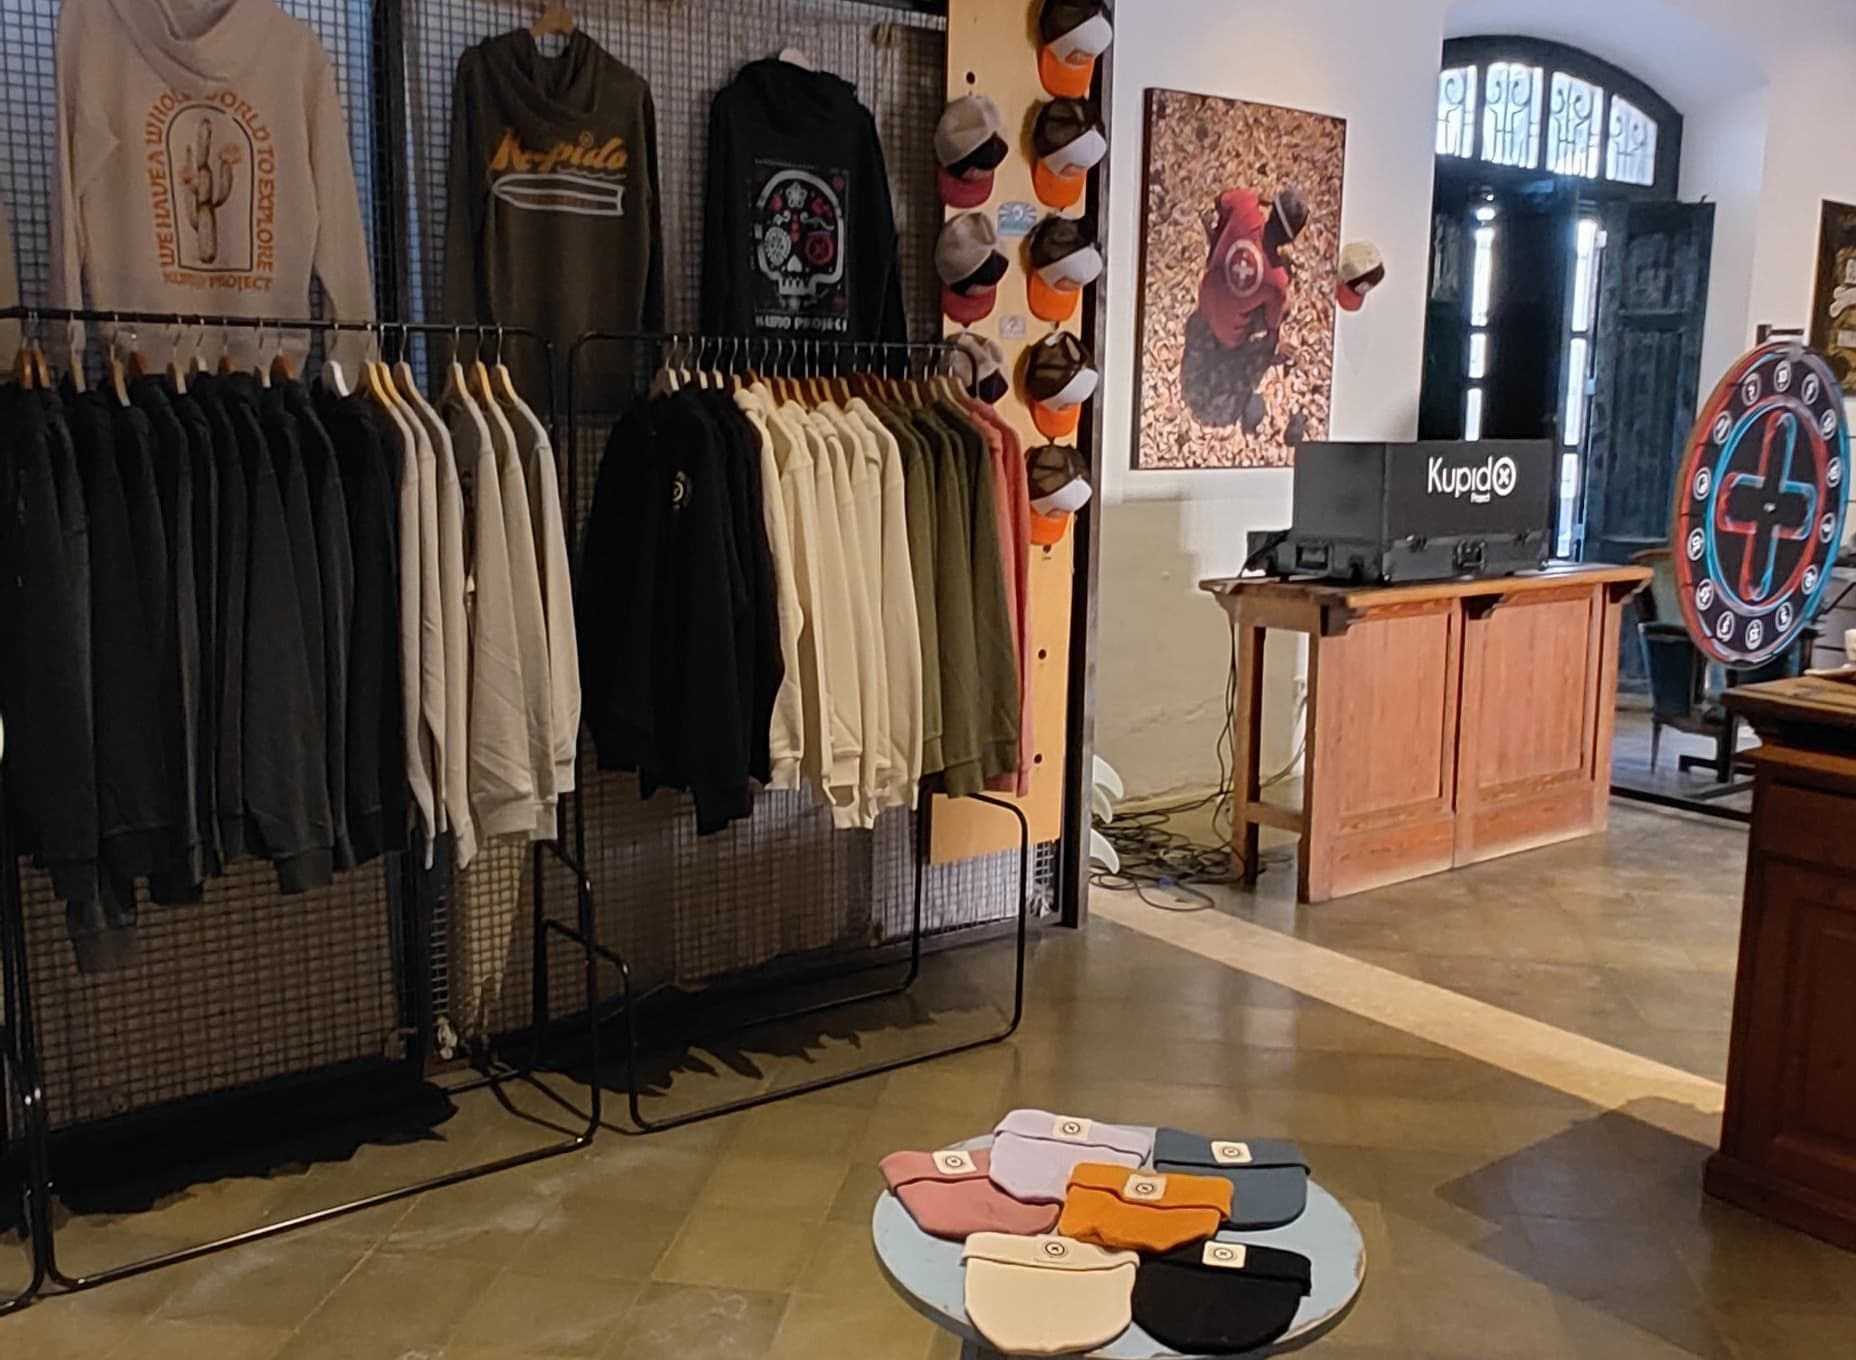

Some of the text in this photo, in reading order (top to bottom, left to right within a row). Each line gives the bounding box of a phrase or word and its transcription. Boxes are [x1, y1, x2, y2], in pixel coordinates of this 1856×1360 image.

[147, 150, 166, 167] A
[256, 145, 275, 176] TO
[149, 168, 173, 230] HAVE
[255, 179, 275, 274] EXPLORE
[157, 231, 175, 269] WE
[208, 274, 273, 293] PROJECT
